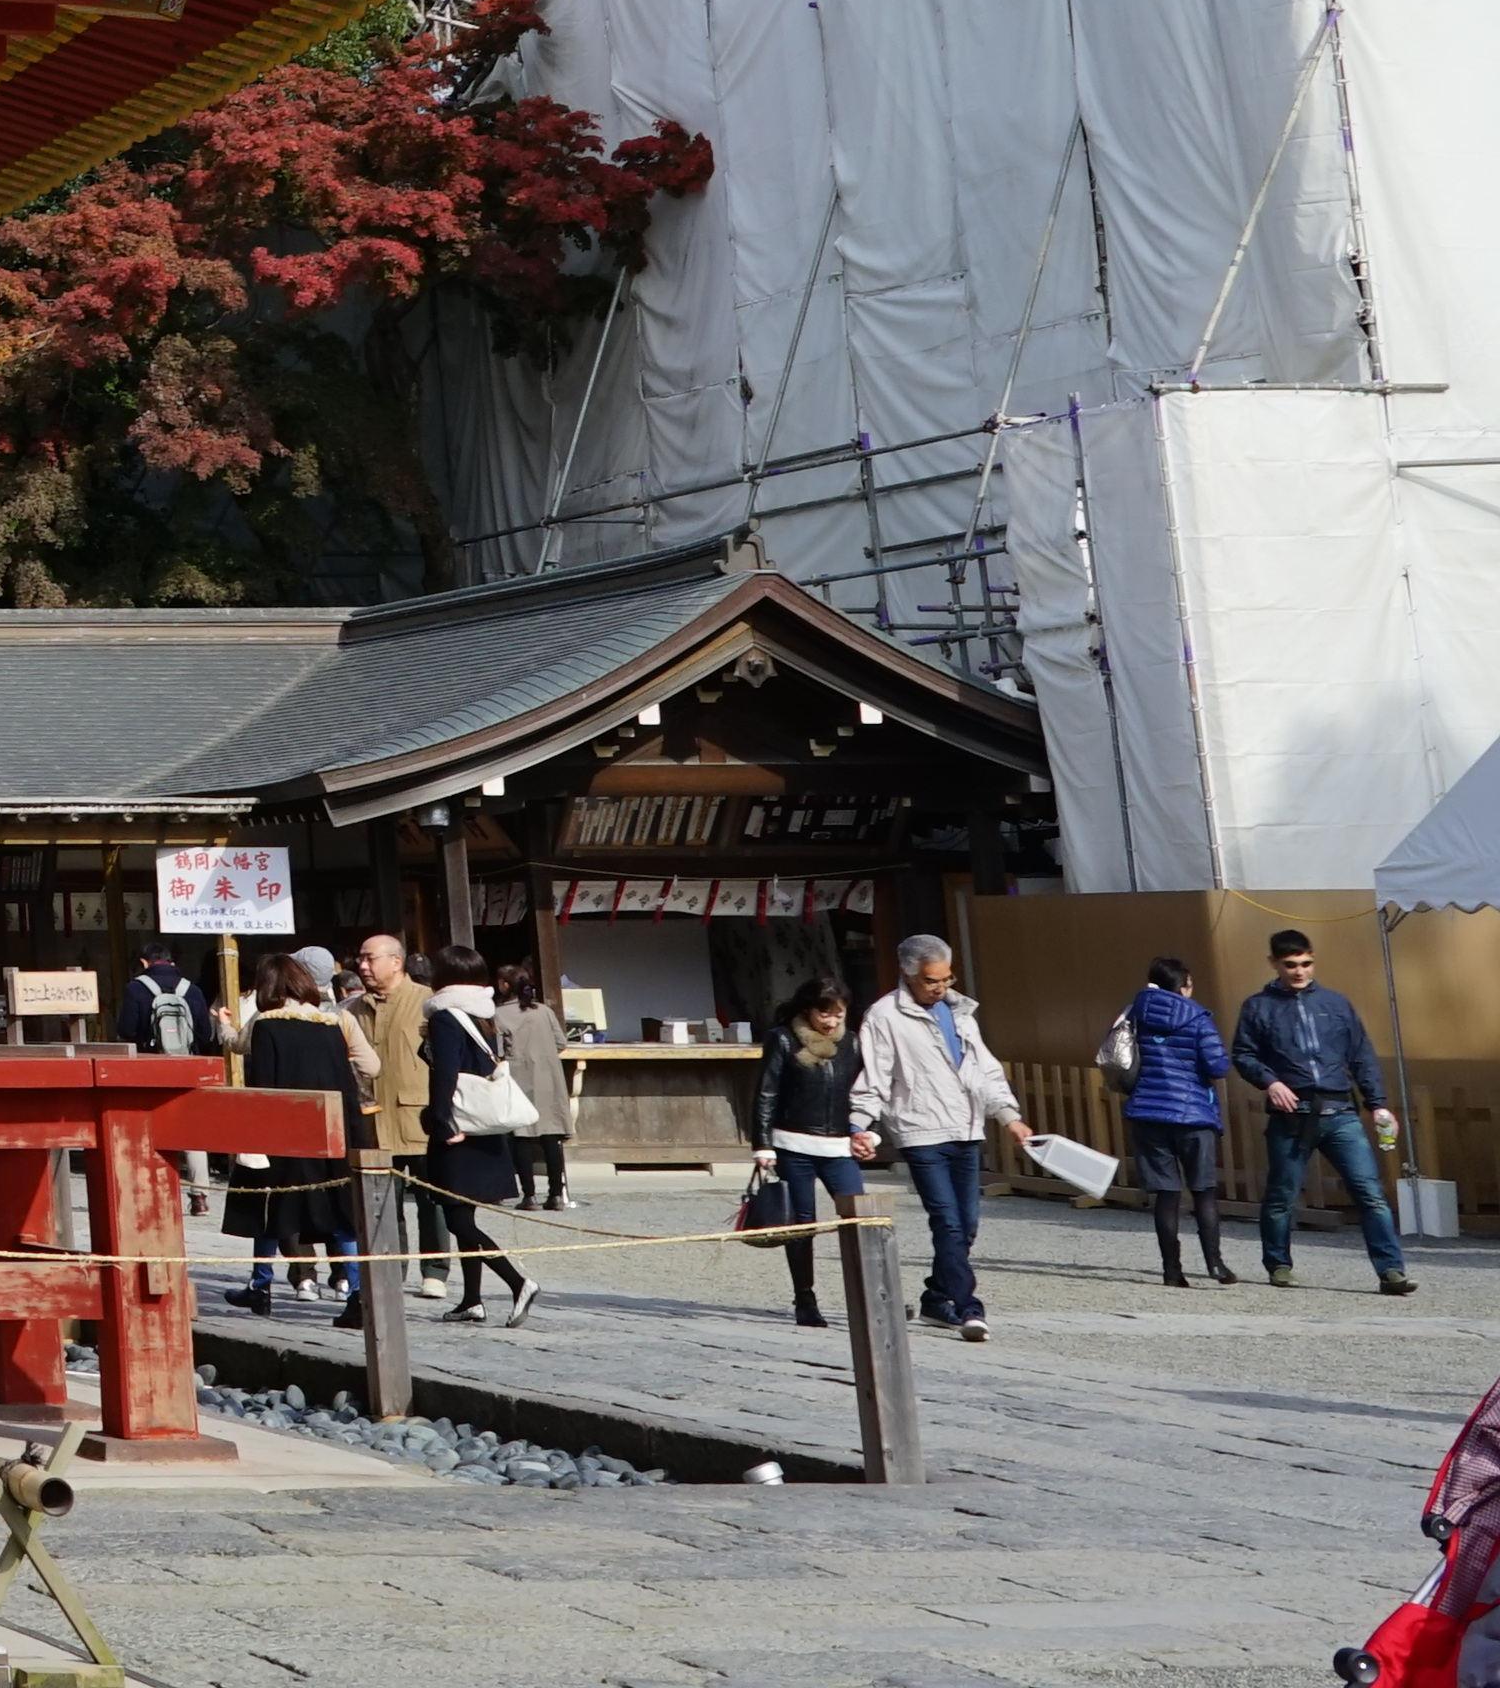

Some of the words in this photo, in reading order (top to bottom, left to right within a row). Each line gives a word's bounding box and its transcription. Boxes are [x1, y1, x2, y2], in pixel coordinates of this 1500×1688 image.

[174, 851, 272, 871] 鶴岡八幡宮
